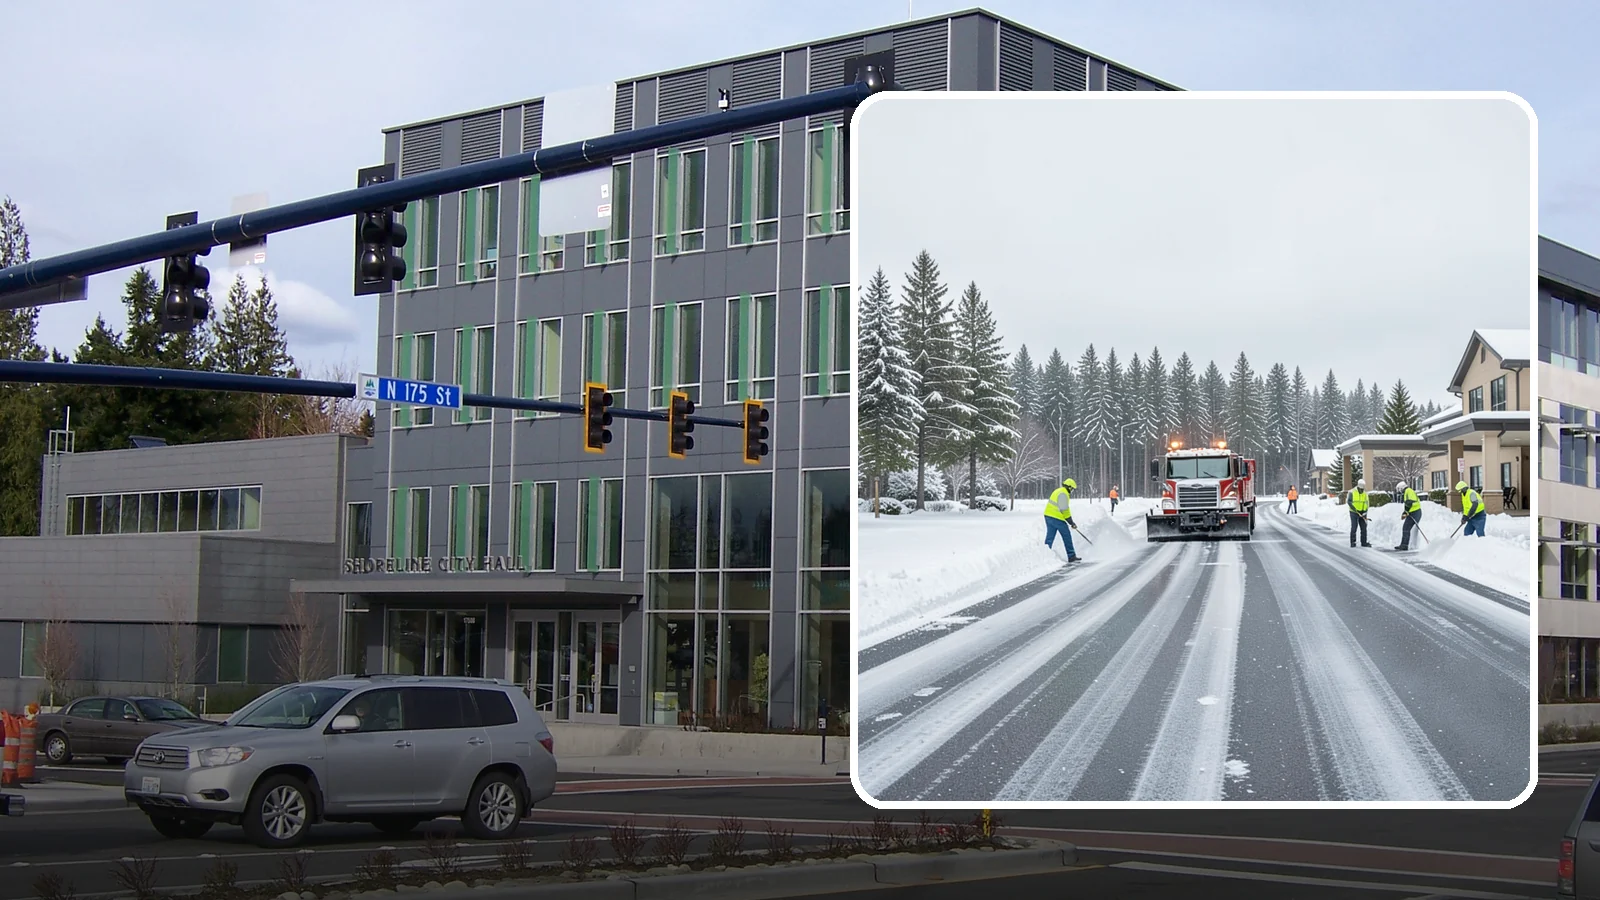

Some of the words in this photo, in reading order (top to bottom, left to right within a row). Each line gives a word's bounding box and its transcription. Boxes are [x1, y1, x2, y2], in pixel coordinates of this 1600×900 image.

[387, 380, 396, 400] N
[405, 382, 428, 403] 175
[436, 386, 451, 406] St
[343, 556, 432, 574] SHORELINE
[438, 555, 475, 572] CITY
[484, 555, 525, 571] HALL
